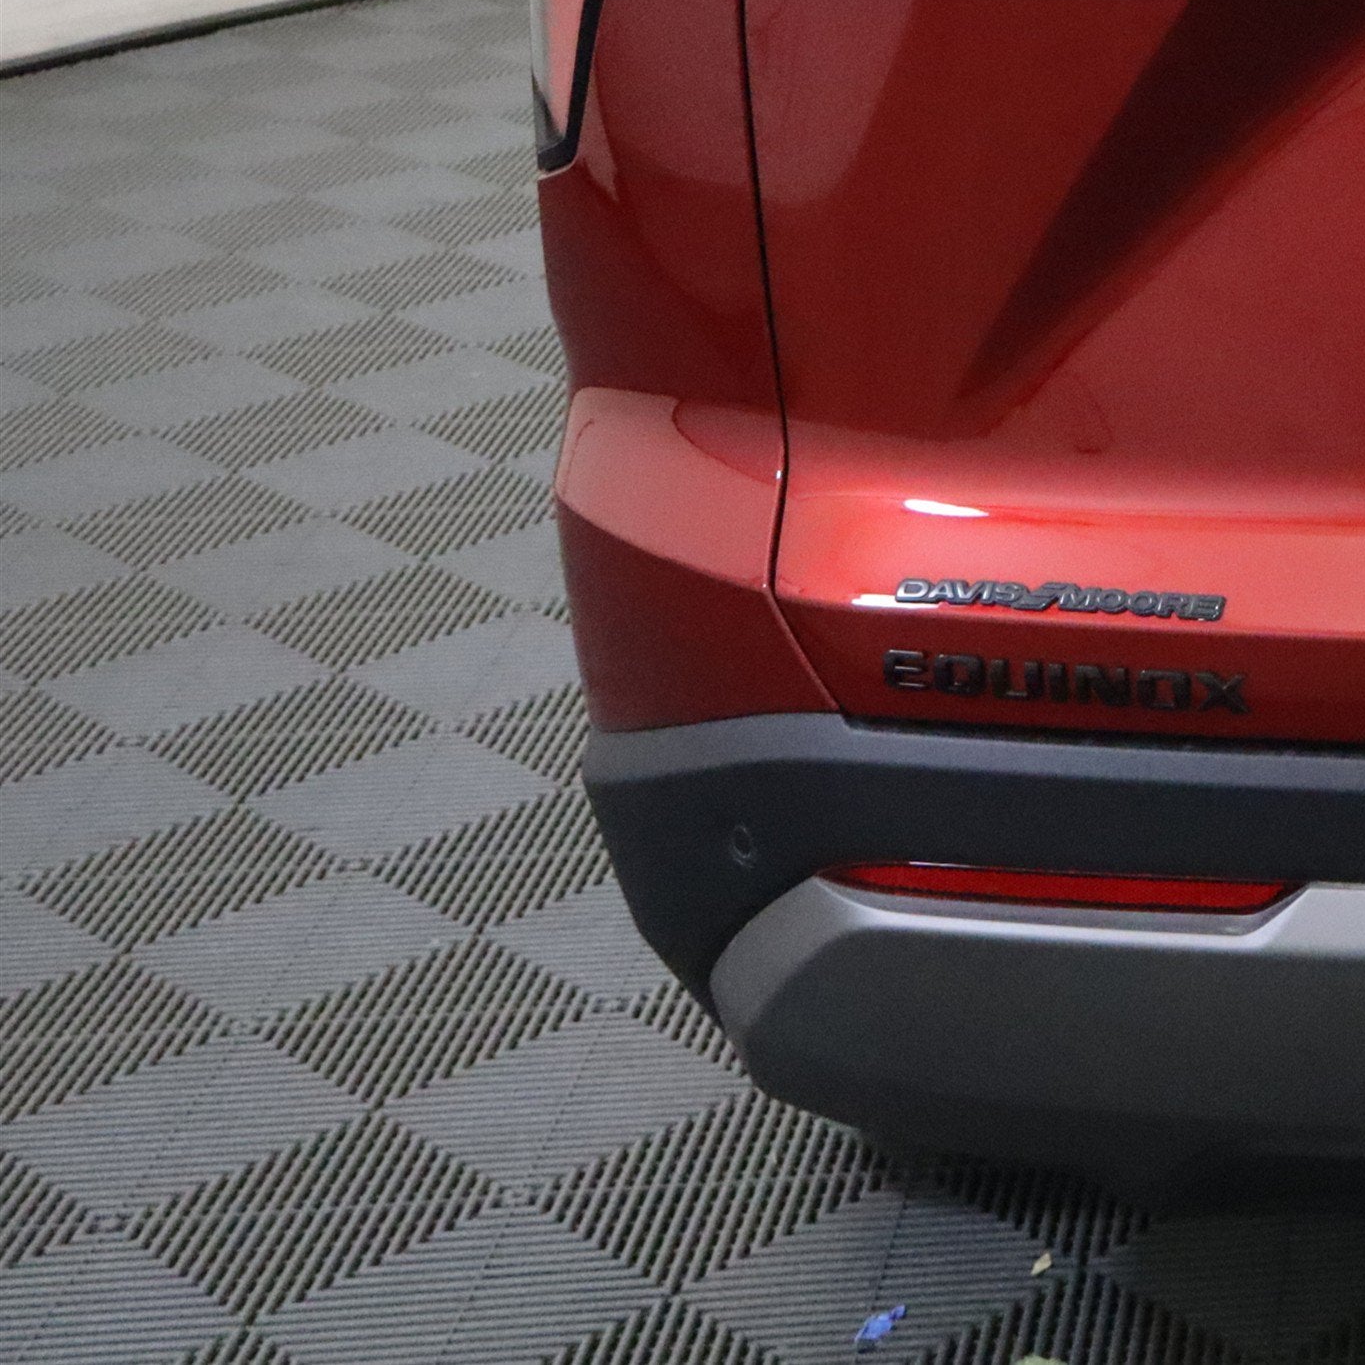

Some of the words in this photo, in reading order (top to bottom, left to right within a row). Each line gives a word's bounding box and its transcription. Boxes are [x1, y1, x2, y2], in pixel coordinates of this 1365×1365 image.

[896, 579, 1022, 604] DAVIS
[1059, 587, 1225, 620] MOORE
[882, 649, 1248, 713] EQUINOX
